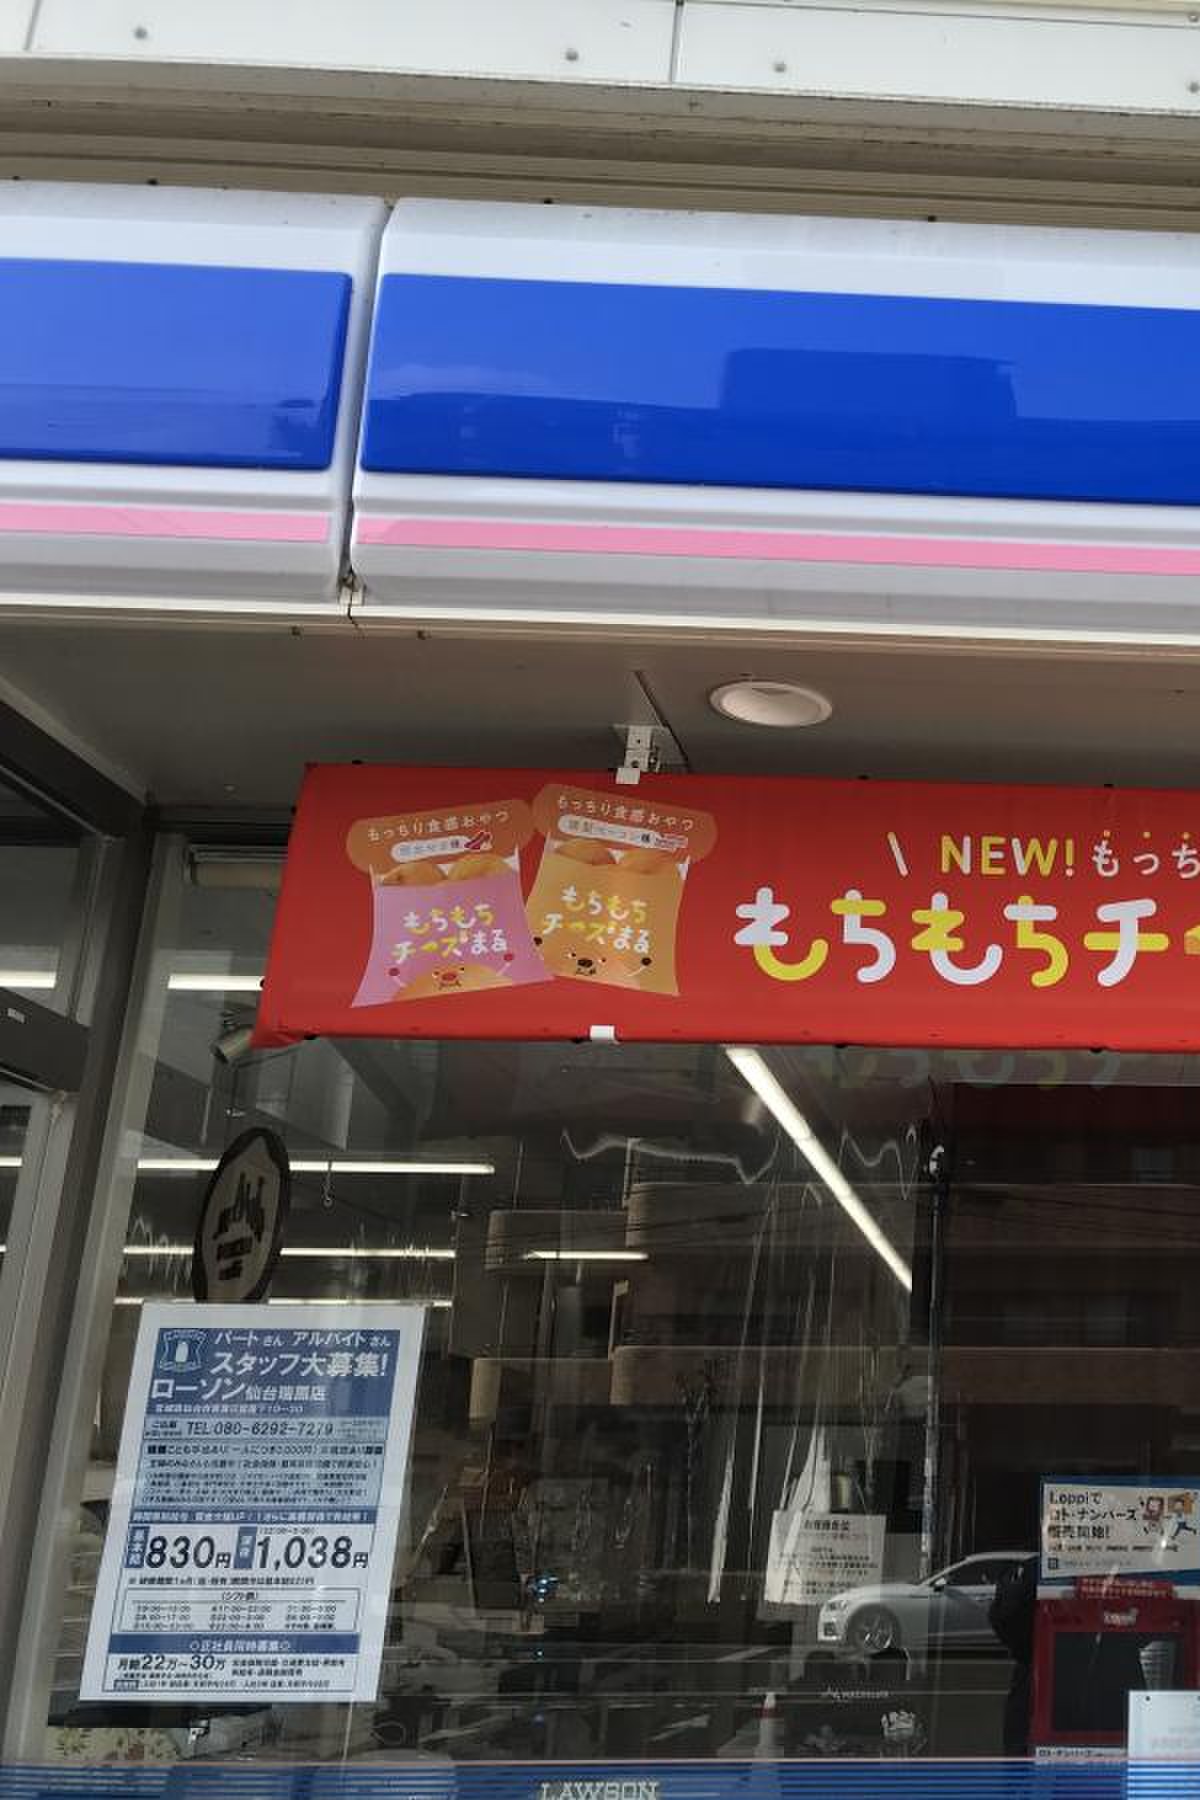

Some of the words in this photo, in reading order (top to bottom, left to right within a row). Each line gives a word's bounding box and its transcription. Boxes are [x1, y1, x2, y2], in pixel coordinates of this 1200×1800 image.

[940, 835, 1075, 878] NEW!
[403, 903, 494, 935] もちもち
[562, 886, 648, 923] もちもち
[391, 928, 509, 964] チーズまる
[543, 912, 652, 954] チーズまる
[209, 1353, 388, 1377] スタッフ大募集!
[145, 1535, 231, 1568] 830円
[256, 1535, 369, 1569] 1,038円
[541, 1781, 660, 1800] LAWSON
